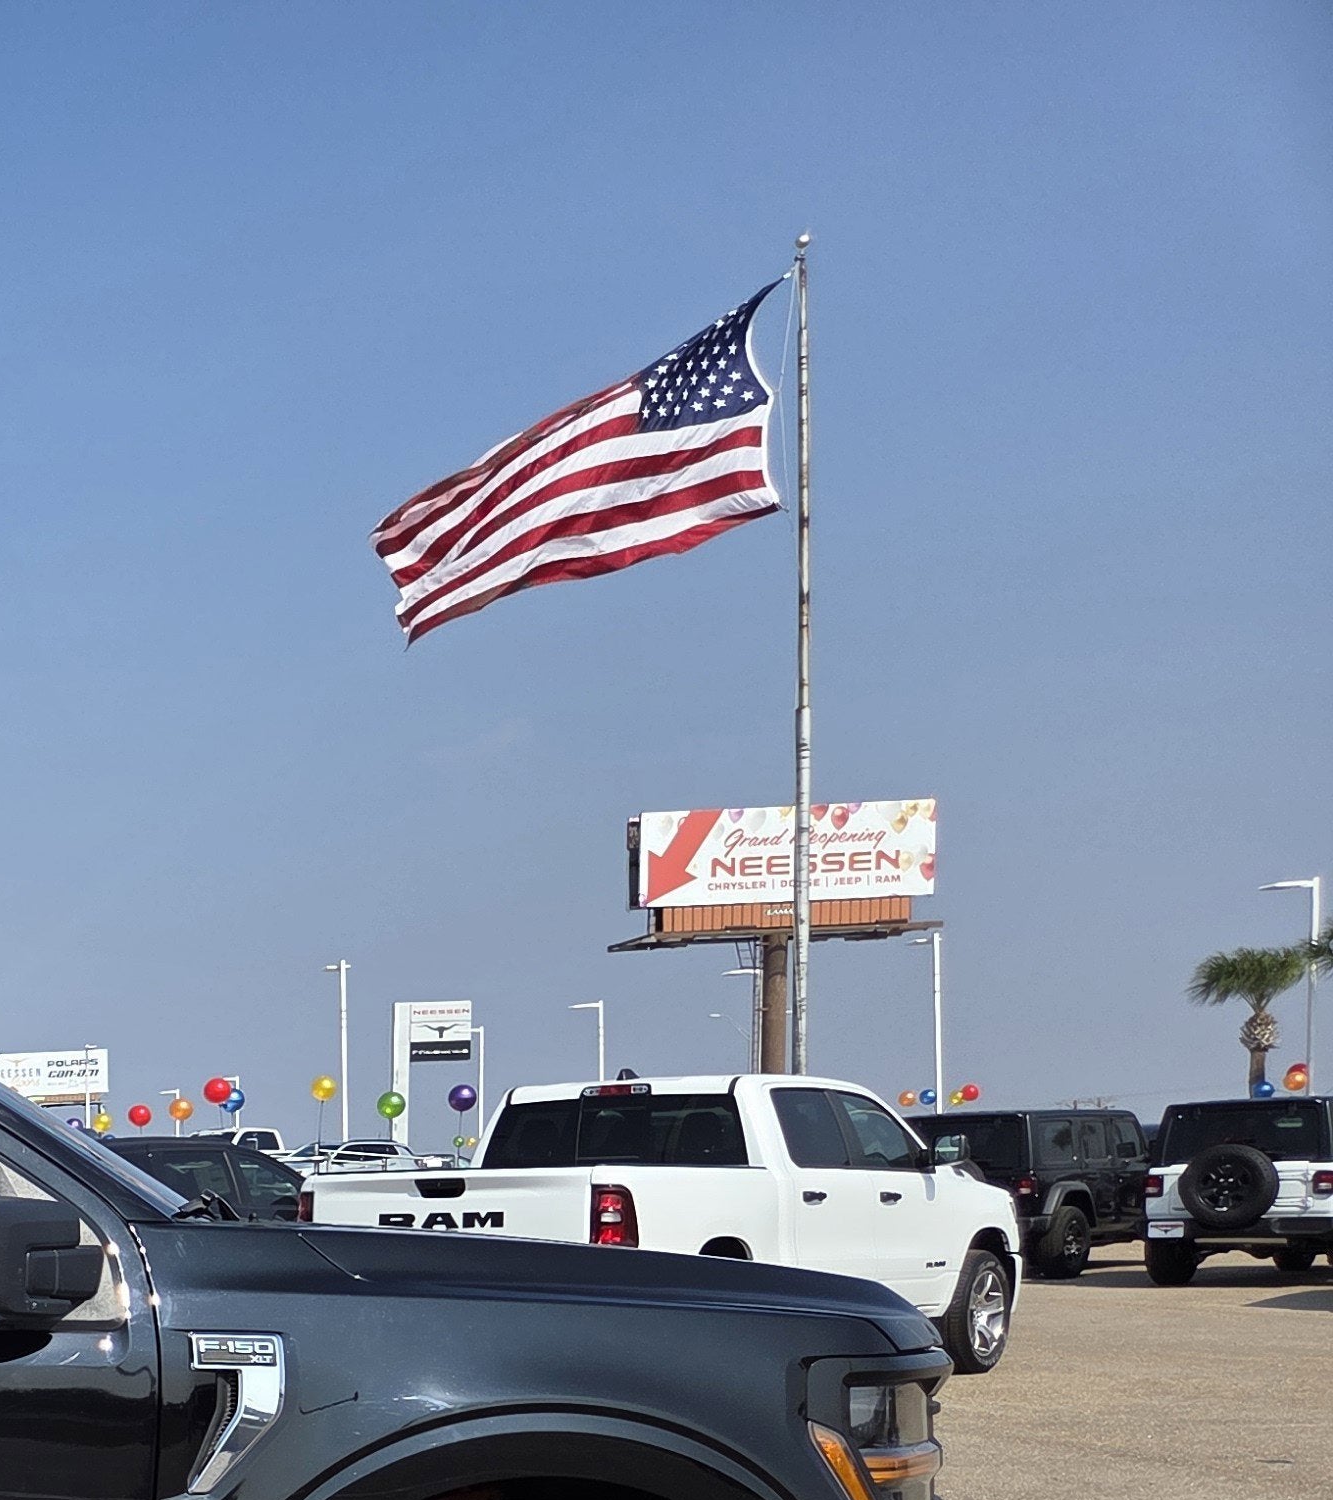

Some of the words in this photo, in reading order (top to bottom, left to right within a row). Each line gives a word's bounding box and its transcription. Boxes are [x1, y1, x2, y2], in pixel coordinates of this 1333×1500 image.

[723, 828, 789, 858] Grand
[707, 880, 767, 892] CHRYSLER
[780, 877, 821, 888] DOE
[833, 875, 863, 887] JEEP
[874, 873, 902, 885] RAM
[47, 1058, 99, 1068] POLARS
[378, 1211, 505, 1230] RAM
[198, 1339, 274, 1354] F-150
[249, 1354, 273, 1364] XLT
